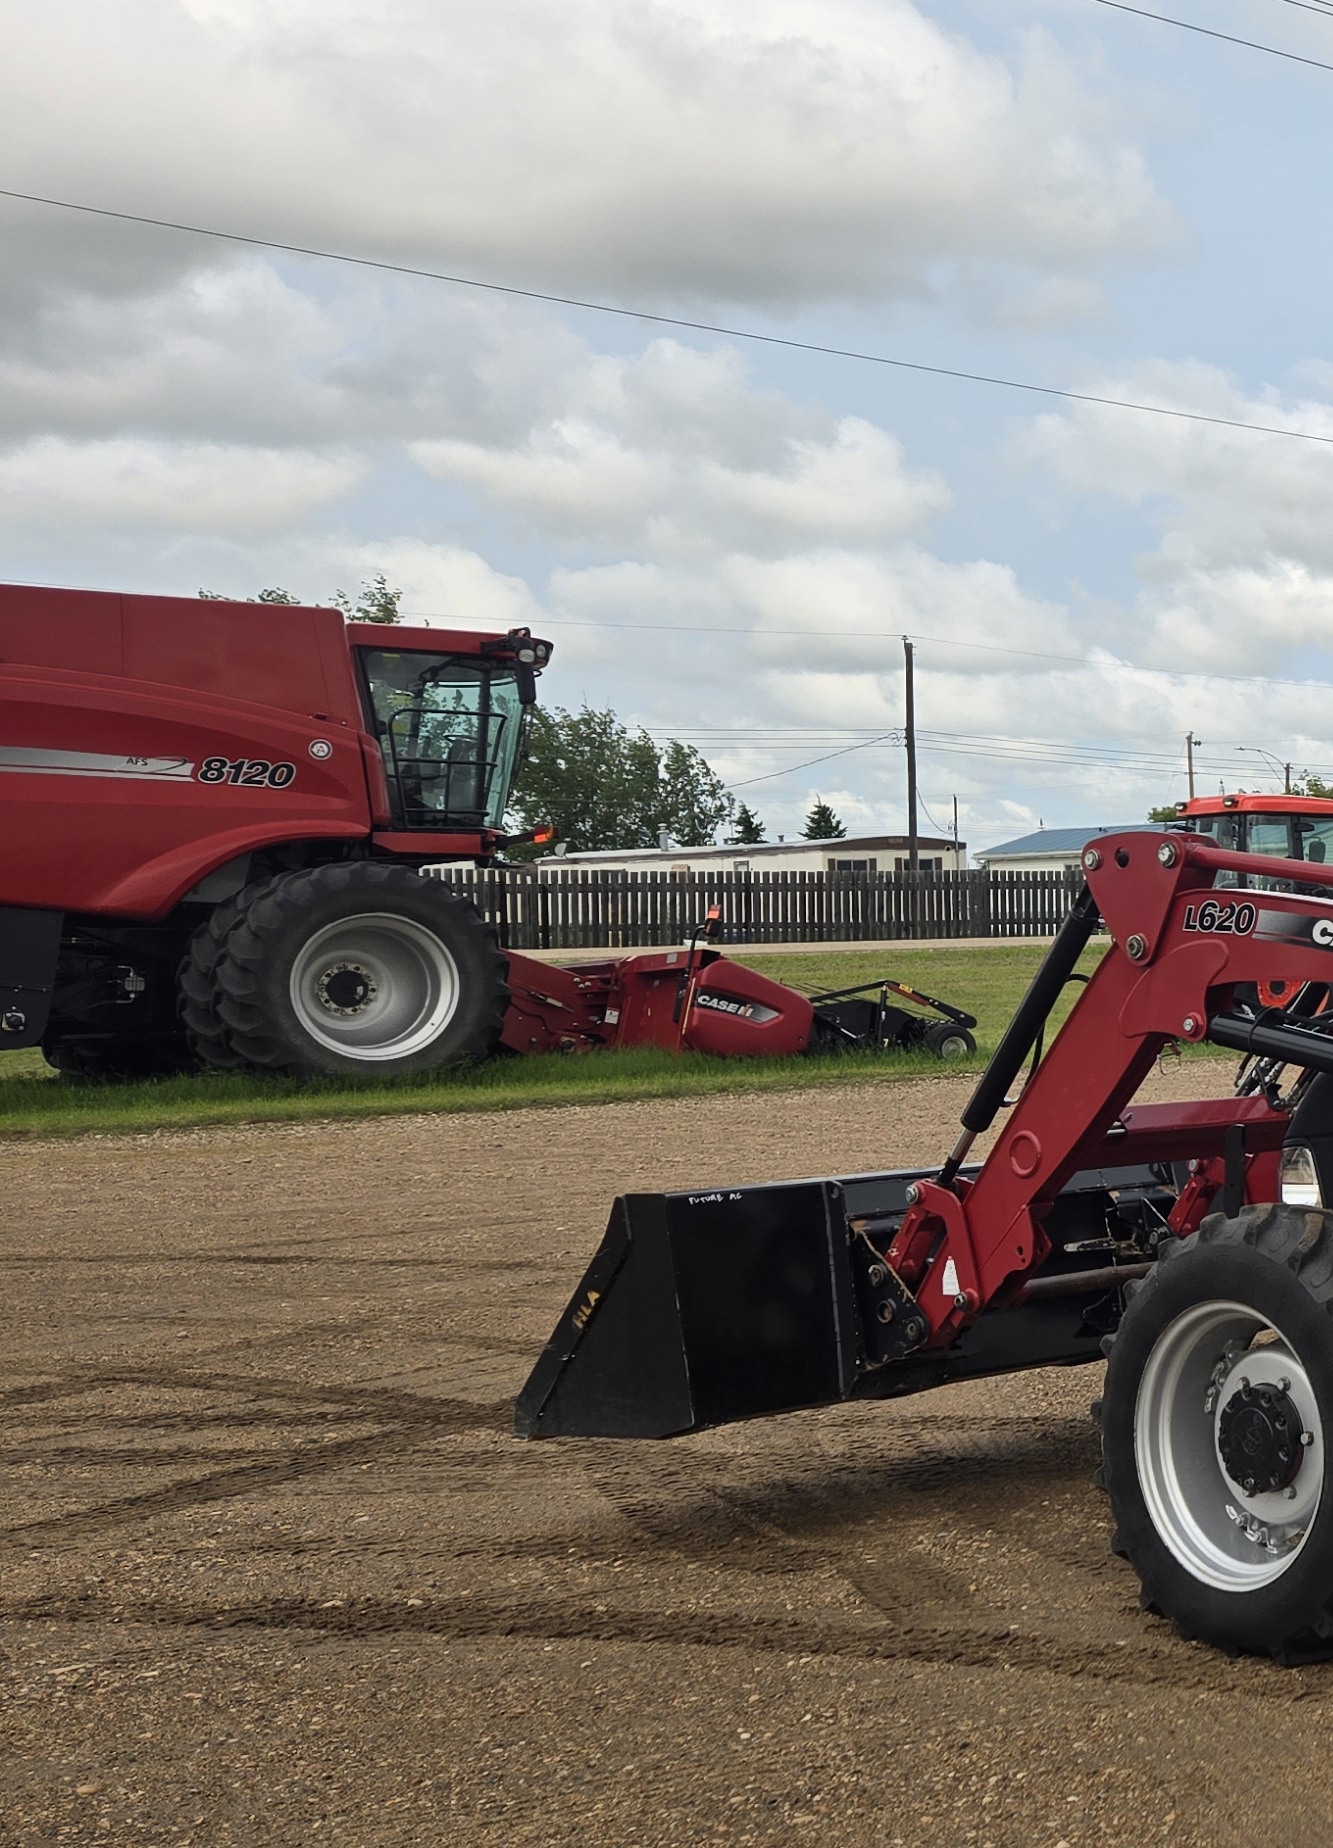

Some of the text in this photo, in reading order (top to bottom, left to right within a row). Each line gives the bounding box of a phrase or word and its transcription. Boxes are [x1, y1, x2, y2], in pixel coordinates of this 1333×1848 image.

[126, 757, 148, 766] AFS
[198, 756, 296, 789] 8120
[1183, 900, 1256, 936] L620
[697, 994, 739, 1013] CASE
[688, 1193, 723, 1205] FUTURE
[572, 1290, 600, 1329] HLA
